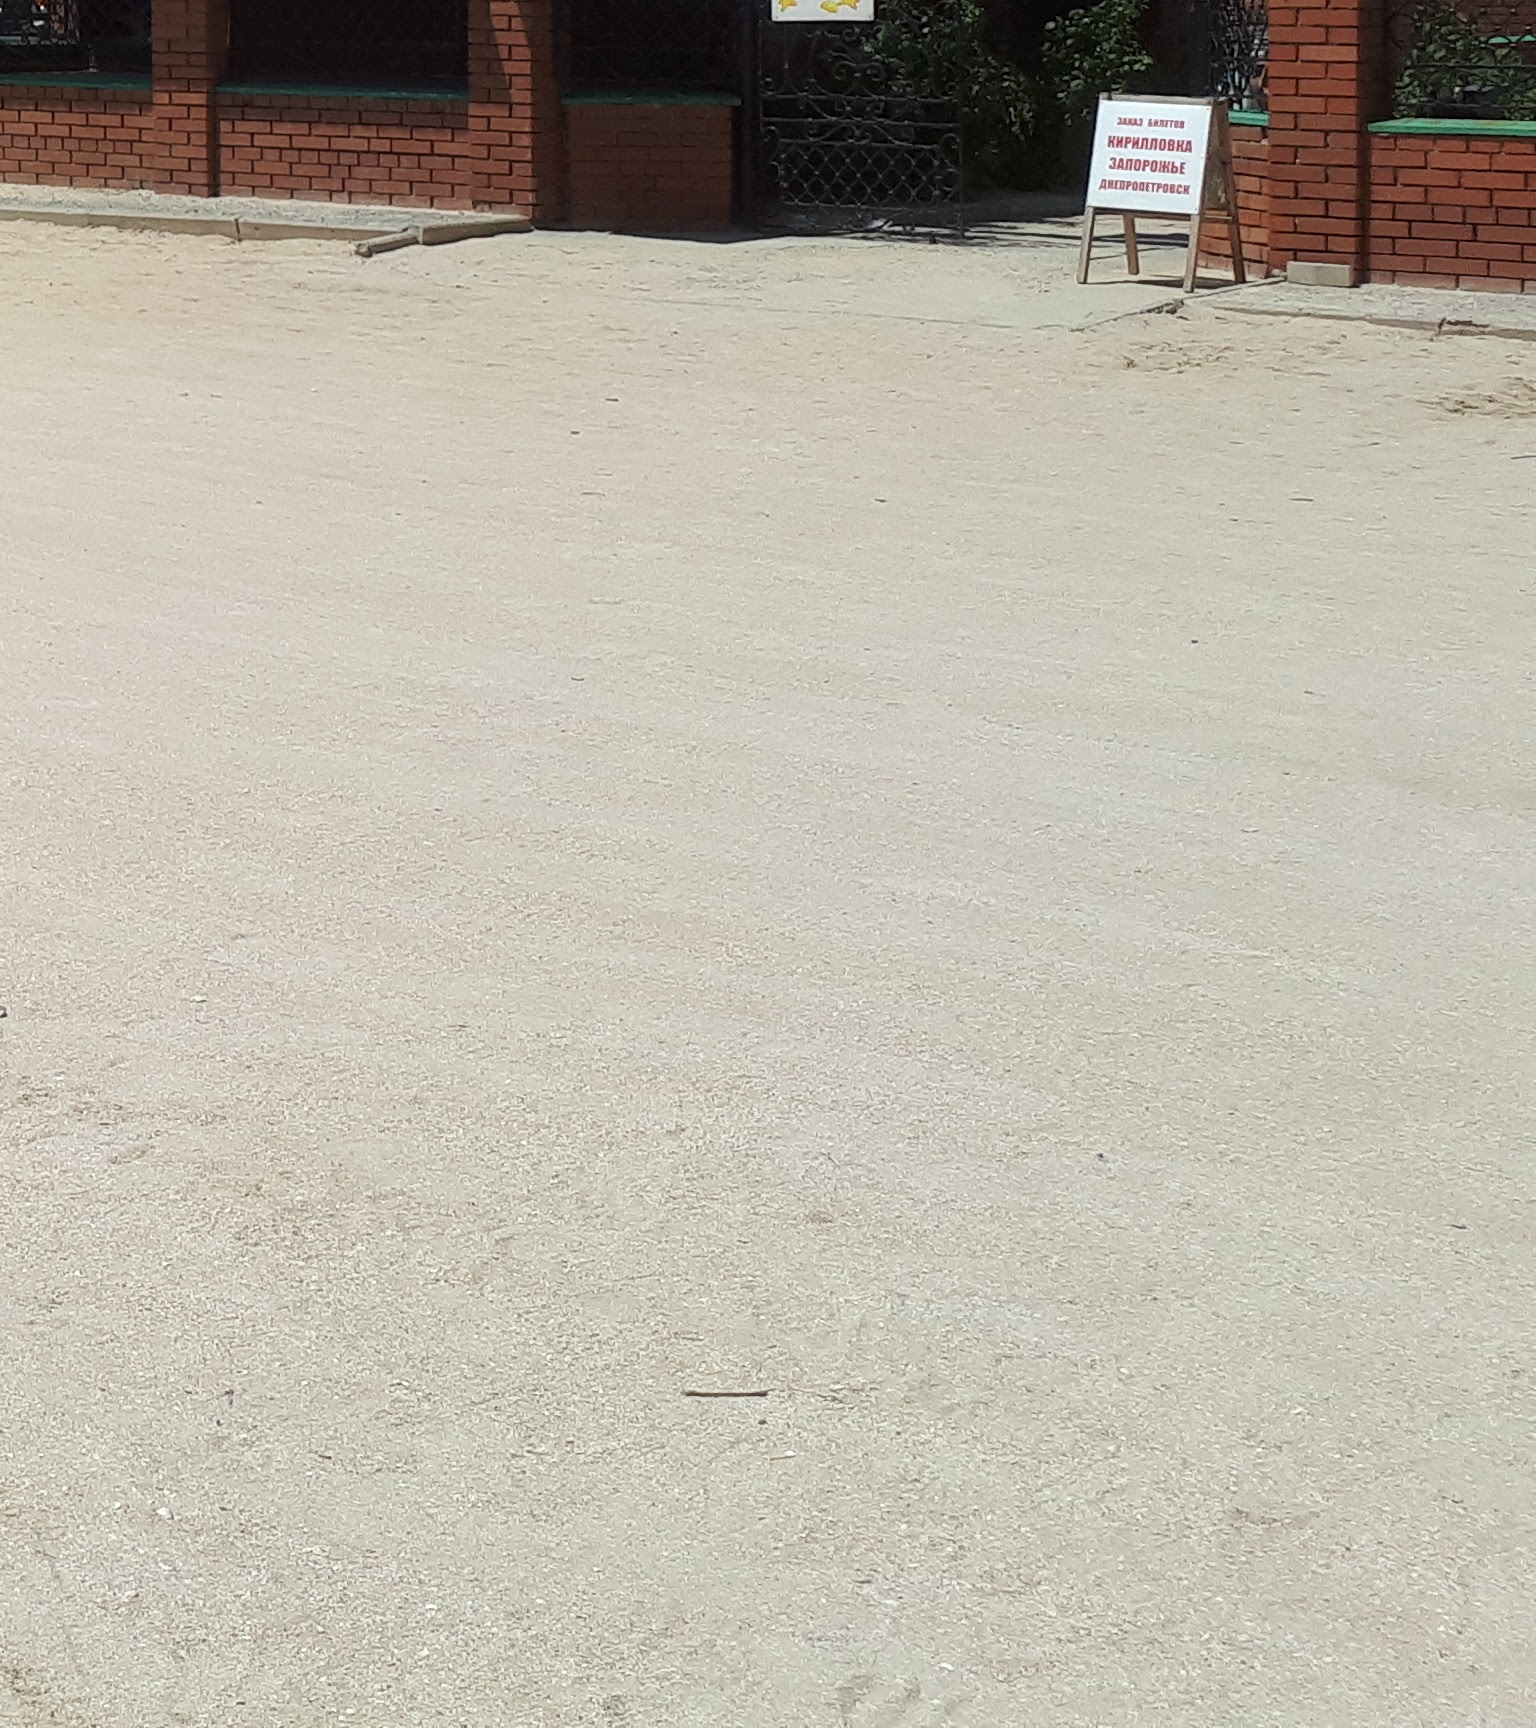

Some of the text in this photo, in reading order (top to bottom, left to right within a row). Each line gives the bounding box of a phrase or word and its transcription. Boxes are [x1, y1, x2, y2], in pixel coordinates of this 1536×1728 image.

[1116, 116, 1186, 130] ЗАКАЗ БИЛЕТОВ
[1107, 135, 1193, 154] КИРИЛЛОВКА
[1108, 157, 1187, 175] ЗАПОРОЖЬЕ
[1098, 178, 1191, 195] ДНЕПРОПЕТРОВСК
